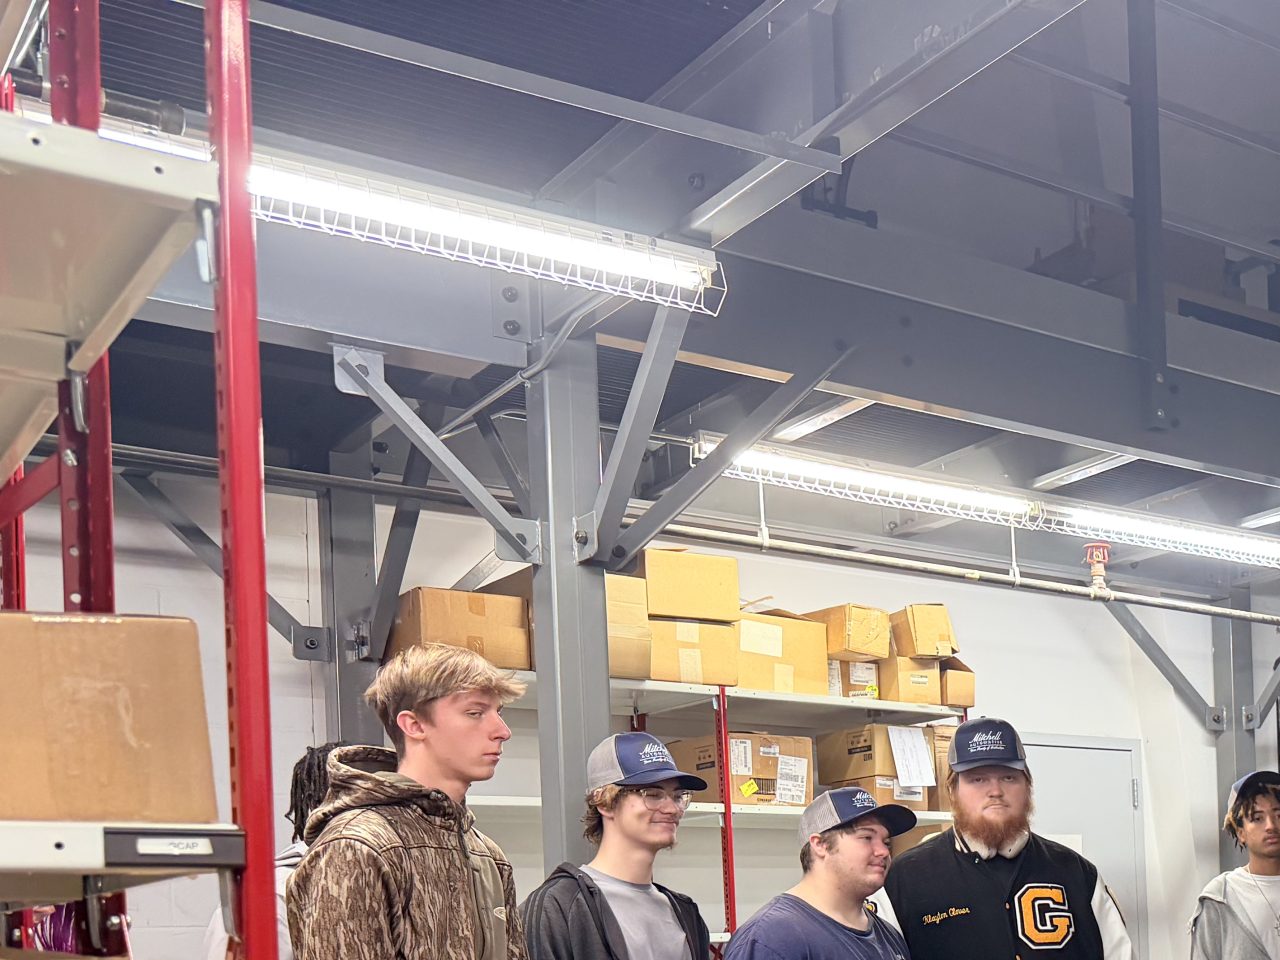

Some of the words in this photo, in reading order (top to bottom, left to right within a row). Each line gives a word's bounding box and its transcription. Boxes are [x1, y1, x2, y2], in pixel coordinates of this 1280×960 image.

[969, 730, 1002, 743] Mitchell
[638, 743, 668, 755] Mitch
[1014, 883, 1075, 949] G
